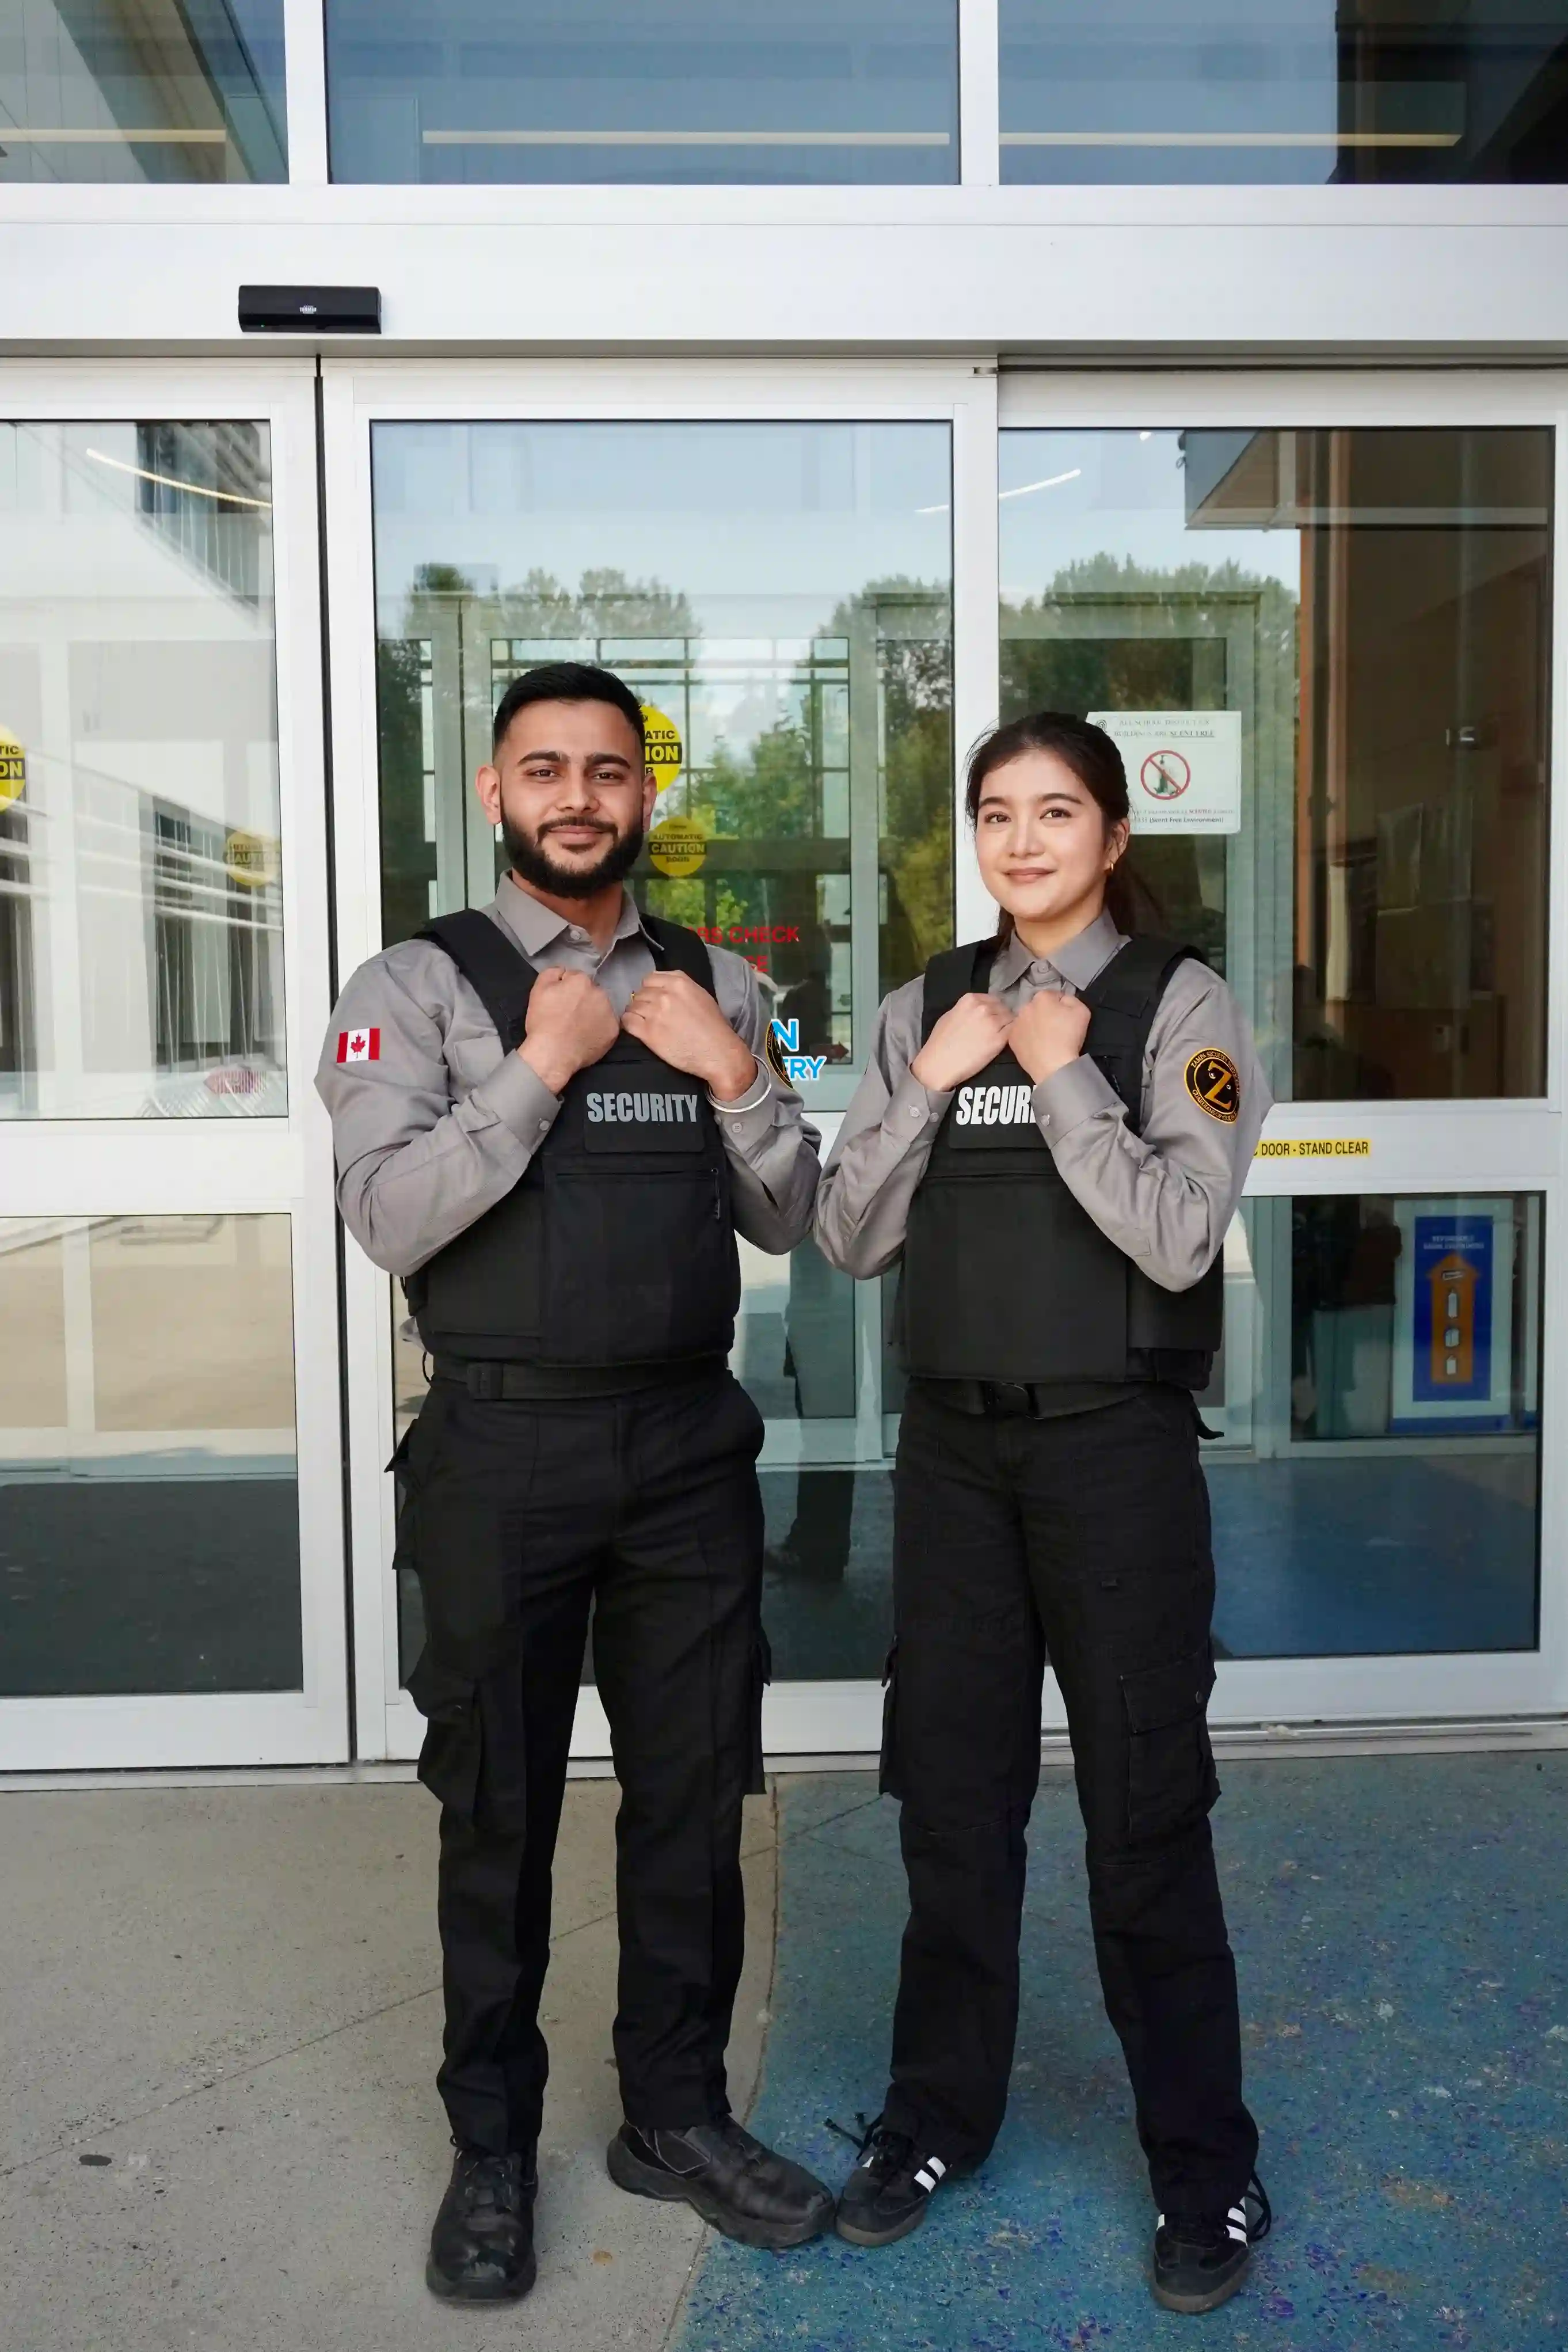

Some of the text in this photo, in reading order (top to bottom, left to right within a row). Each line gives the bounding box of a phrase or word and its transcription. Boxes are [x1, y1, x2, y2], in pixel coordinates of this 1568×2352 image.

[645, 730, 675, 739] ATIC
[645, 746, 679, 761] ION
[0, 761, 22, 777] ON
[651, 843, 705, 854] CAUTION
[690, 926, 800, 944] RS CHECK
[1191, 1052, 1207, 1069] ZAMPA
[1204, 1061, 1232, 1111] Z
[587, 1093, 697, 1123] SECURITY
[1261, 1143, 1290, 1156] DOOR
[1299, 1142, 1332, 1155] STAND
[1335, 1141, 1368, 1154] CLEAR
